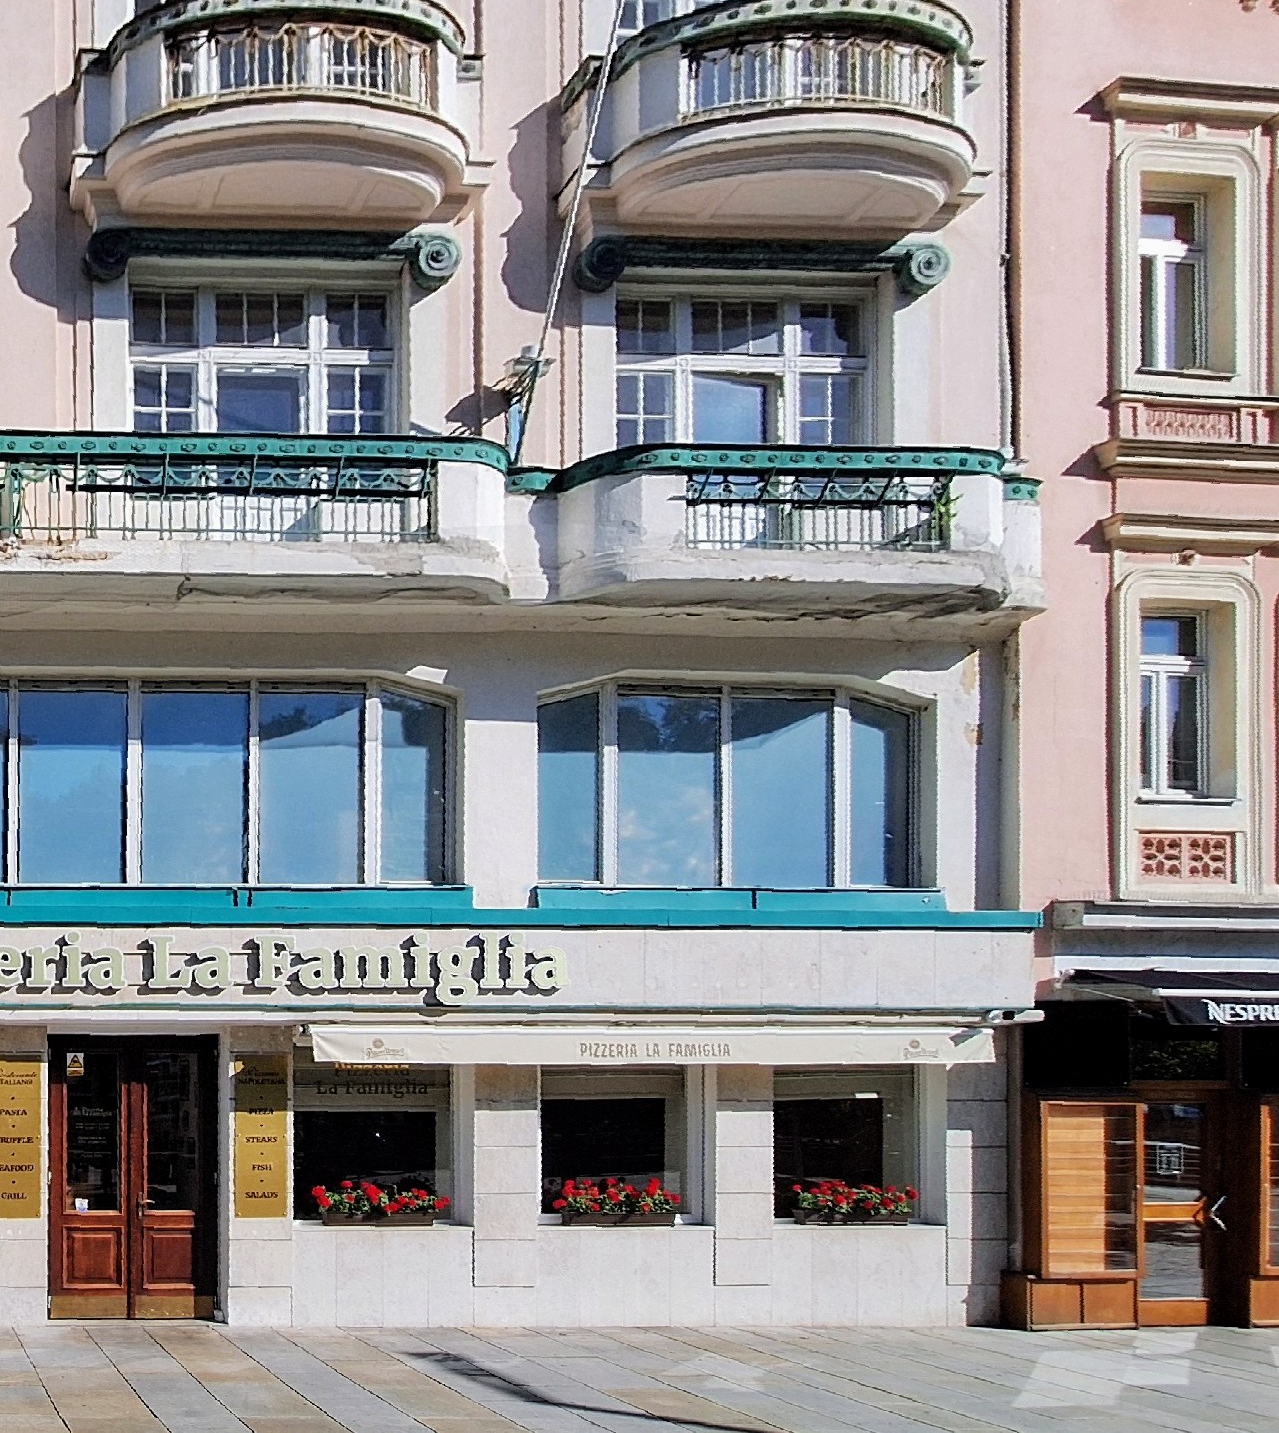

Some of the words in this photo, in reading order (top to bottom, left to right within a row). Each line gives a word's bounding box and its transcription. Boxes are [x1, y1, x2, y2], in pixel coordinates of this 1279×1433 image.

[148, 935, 232, 989] La
[254, 931, 572, 1005] Famiglia
[579, 1042, 638, 1058] PIZZERIA
[646, 1042, 660, 1057] LA
[669, 1043, 731, 1057] FAMIGLIA
[0, 1108, 28, 1116] PASTA
[0, 1192, 28, 1200] GRILL
[245, 1191, 279, 1199] SALADS
